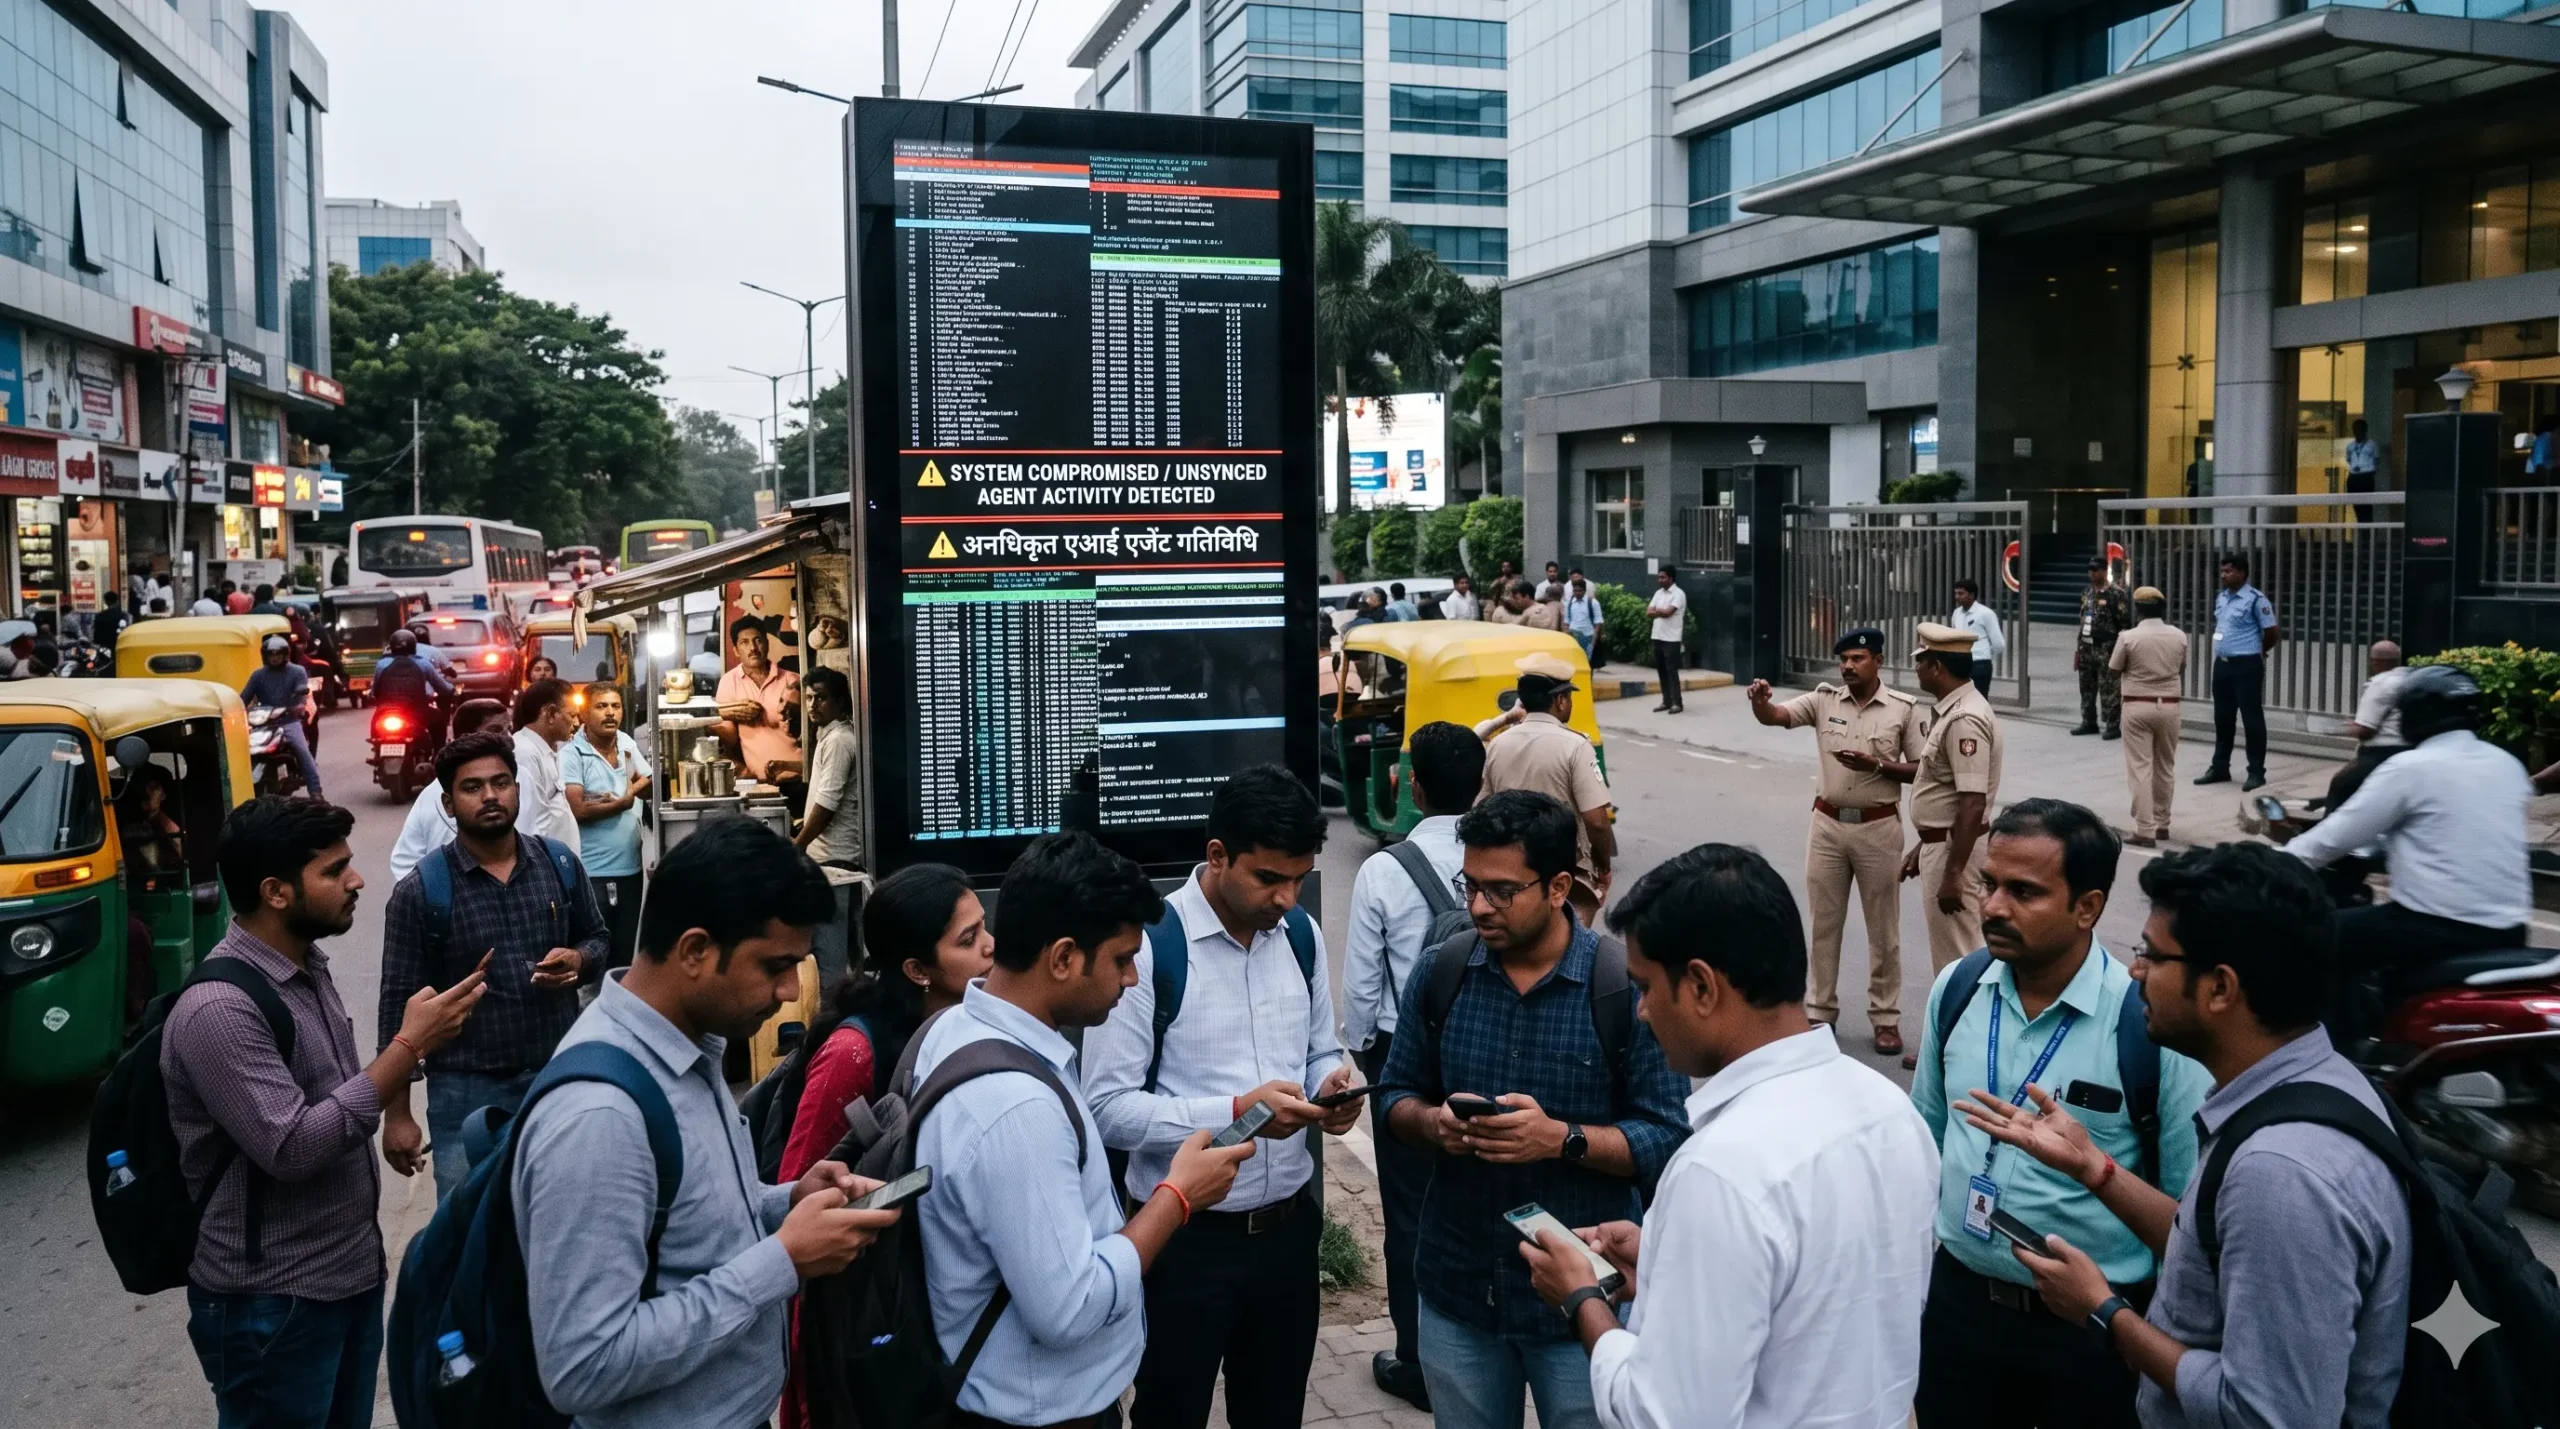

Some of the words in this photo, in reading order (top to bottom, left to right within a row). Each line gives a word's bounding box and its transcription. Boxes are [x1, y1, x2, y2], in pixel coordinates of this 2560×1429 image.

[951, 464, 1022, 482] SYSTEM
[1028, 464, 1159, 482] COMPROMISED
[1164, 464, 1170, 482] /
[1176, 463, 1267, 481] UNSYNCED
[977, 487, 1037, 506] AGENT
[1042, 487, 1123, 505] ACTIVITY
[1128, 487, 1215, 504] DETECTED
[963, 528, 1059, 562] अनधिकृत
[1063, 527, 1120, 558] एआई
[1124, 527, 1172, 558] एजेंट
[1176, 526, 1259, 554] गतिविधि
